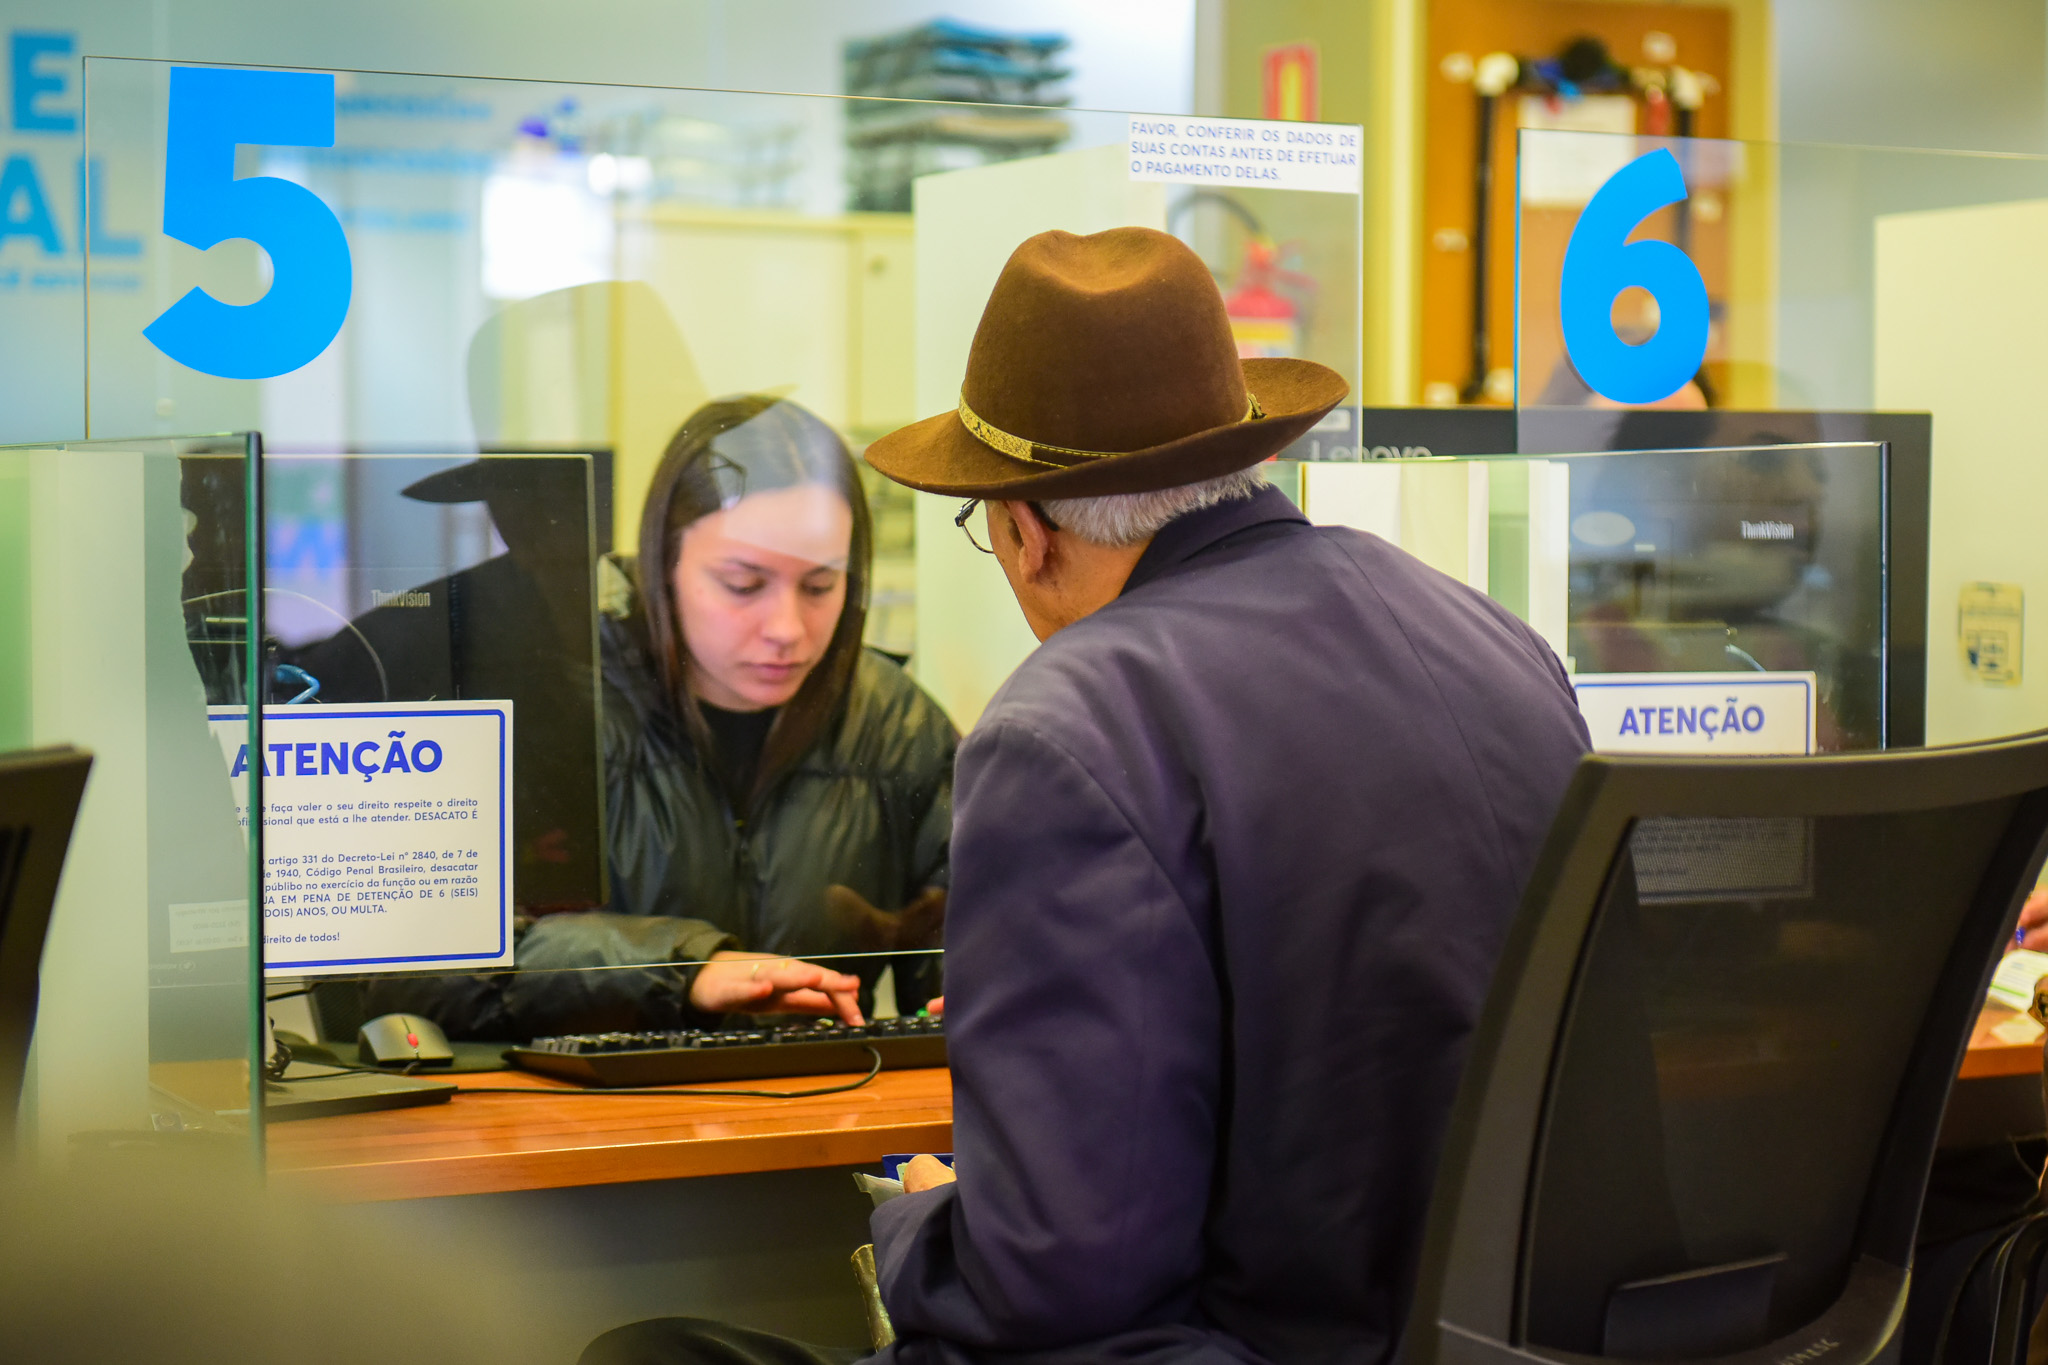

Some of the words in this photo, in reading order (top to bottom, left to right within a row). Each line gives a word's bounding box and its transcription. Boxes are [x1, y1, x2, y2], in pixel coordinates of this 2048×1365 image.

[1185, 124, 1254, 141] CONFERIR
[1261, 129, 1279, 142] OS
[1287, 131, 1333, 146] DADOS
[1340, 134, 1356, 147] DE
[1131, 141, 1166, 155] SUAS
[1170, 143, 1226, 159] CONTAS
[1231, 146, 1272, 161] ANTES
[1277, 149, 1293, 162] DE
[1299, 150, 1356, 166] EFETUAR
[1131, 160, 1142, 173] O
[1146, 161, 1231, 178] PAGAMENTO
[1236, 166, 1281, 180] DELAS.
[142, 66, 352, 379] 5
[1560, 147, 1710, 404] 6
[1741, 520, 1795, 540] ThinkVision
[371, 589, 431, 608] ThinkVision
[1619, 697, 1765, 742] ATENÇÃO
[230, 731, 443, 783] ATENÇÃO
[271, 802, 293, 814] faça
[297, 802, 322, 812] valer
[326, 803, 333, 811] o
[337, 803, 354, 811] seu
[358, 800, 390, 810] direito
[394, 799, 432, 810] respeite
[447, 798, 478, 808] direito
[296, 817, 315, 827] que
[318, 814, 339, 824] está
[342, 816, 349, 824] a
[352, 814, 367, 823] lhe
[371, 812, 411, 823] atender.
[414, 811, 468, 821] DESACATO
[472, 808, 478, 819] É
[268, 855, 299, 867] artigo
[302, 855, 318, 864] 331
[321, 854, 334, 863] do
[338, 852, 395, 863] Decreto-Lei
[412, 850, 438, 861] 2840,
[442, 849, 454, 859] de
[457, 849, 463, 858] 7
[466, 848, 478, 858] de
[276, 868, 301, 879] 1940,
[306, 867, 341, 878] Código
[346, 865, 374, 875] Penal
[378, 863, 426, 874] Brasileiro,
[430, 862, 478, 873] desacatar
[321, 880, 364, 889] exercício
[367, 878, 380, 888] da
[382, 877, 416, 889] função
[419, 878, 431, 886] ou
[433, 878, 448, 886] em
[451, 874, 478, 885] razão
[281, 895, 297, 904] EM
[303, 893, 331, 903] PENA
[337, 892, 351, 902] DE
[357, 888, 414, 901] DETENÇÃO
[419, 890, 433, 899] DE
[439, 889, 445, 898] 6
[450, 887, 478, 899] (SEIS)
[264, 907, 294, 918] DOIS)
[296, 906, 328, 917] ANOS,
[331, 905, 347, 915] OU
[350, 903, 387, 914] MULTA.
[295, 934, 306, 943] de
[310, 931, 340, 942] todos!
